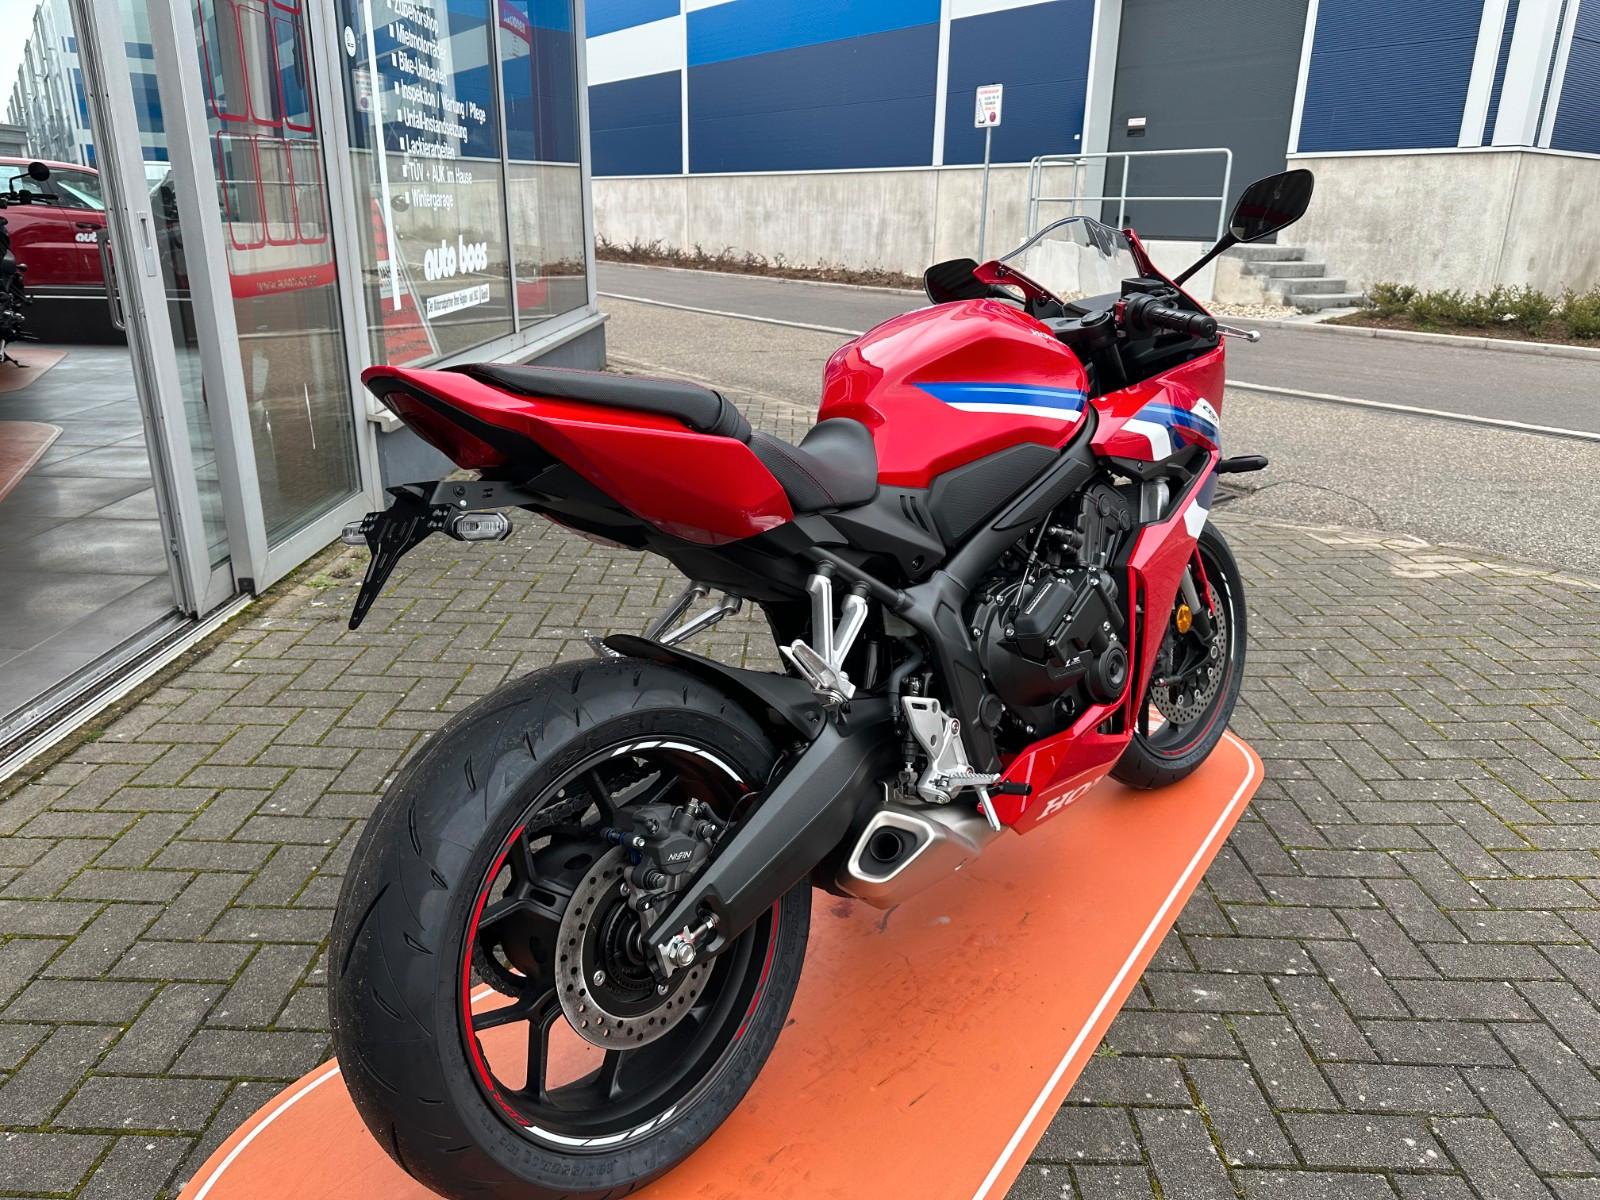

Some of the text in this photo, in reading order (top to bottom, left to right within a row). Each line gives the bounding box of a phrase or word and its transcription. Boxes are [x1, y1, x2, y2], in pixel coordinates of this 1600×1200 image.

[396, 22, 447, 62] Mietmotorräder
[398, 50, 448, 86] Bike-Umbauten
[401, 79, 436, 108] Inspektion
[441, 92, 465, 120] Wartung
[469, 101, 486, 125] Pflege
[403, 107, 468, 143] Unfall-Instandsetzung
[406, 134, 456, 160] Lackierarbeiten
[409, 159, 424, 182] TÜV
[446, 166, 455, 183] im
[455, 167, 473, 185] Hause
[411, 188, 454, 212] Wintergarage
[75, 231, 98, 243] aut
[424, 234, 488, 282] auto boos
